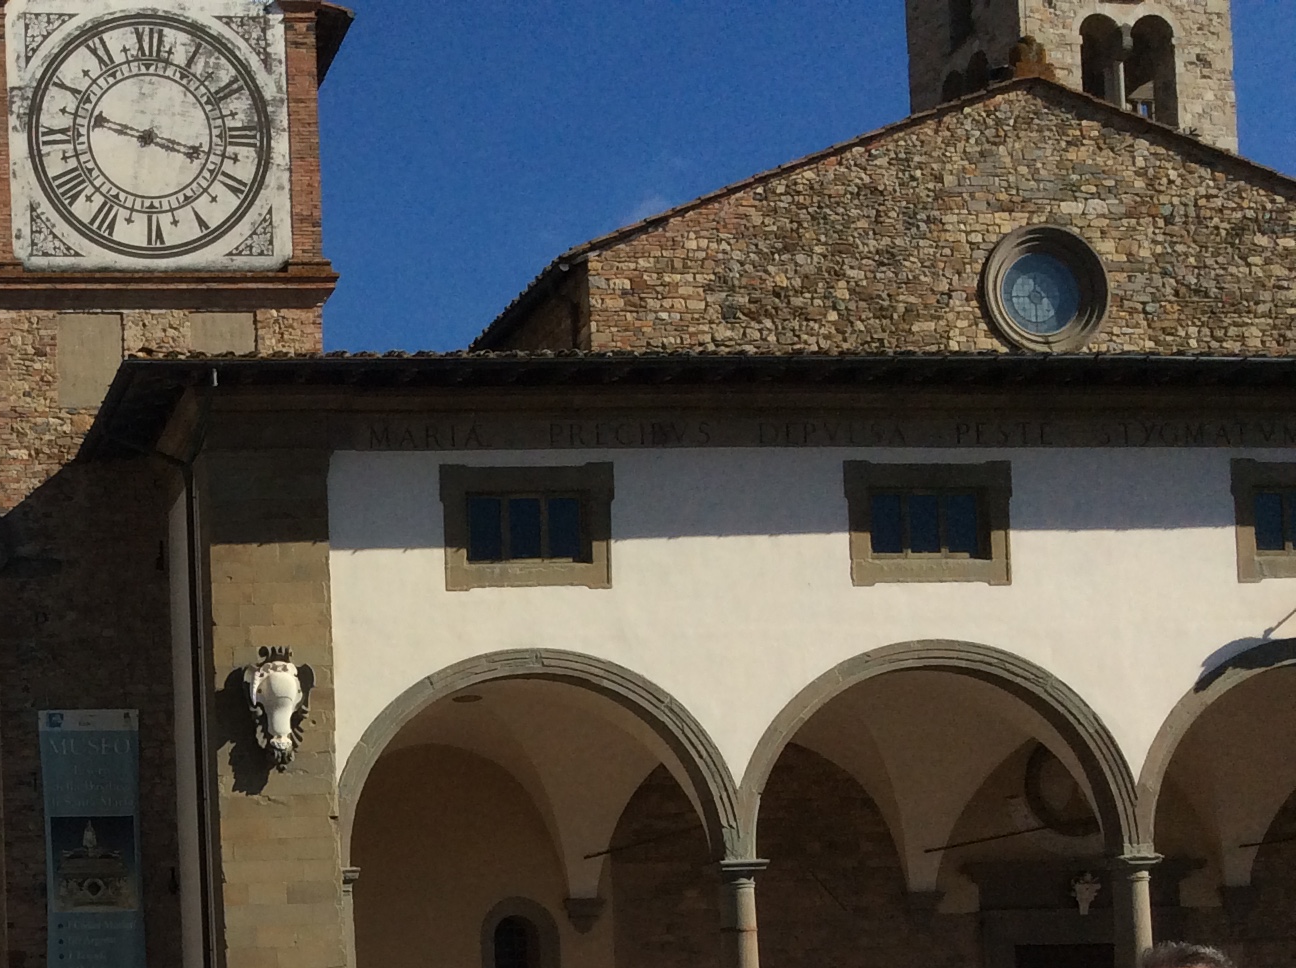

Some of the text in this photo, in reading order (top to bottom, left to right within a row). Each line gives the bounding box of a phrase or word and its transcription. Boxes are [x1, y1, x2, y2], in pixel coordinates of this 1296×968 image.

[84, 35, 116, 71] XI
[134, 27, 163, 58] XII
[185, 42, 202, 69] I
[52, 75, 82, 100] X
[214, 76, 245, 102] II
[41, 124, 72, 146] IX
[227, 125, 258, 148] III
[51, 166, 89, 207] VIII
[88, 200, 119, 238] VII
[146, 214, 166, 246] VI
[191, 205, 211, 233] V
[48, 736, 131, 755] MUSEO
